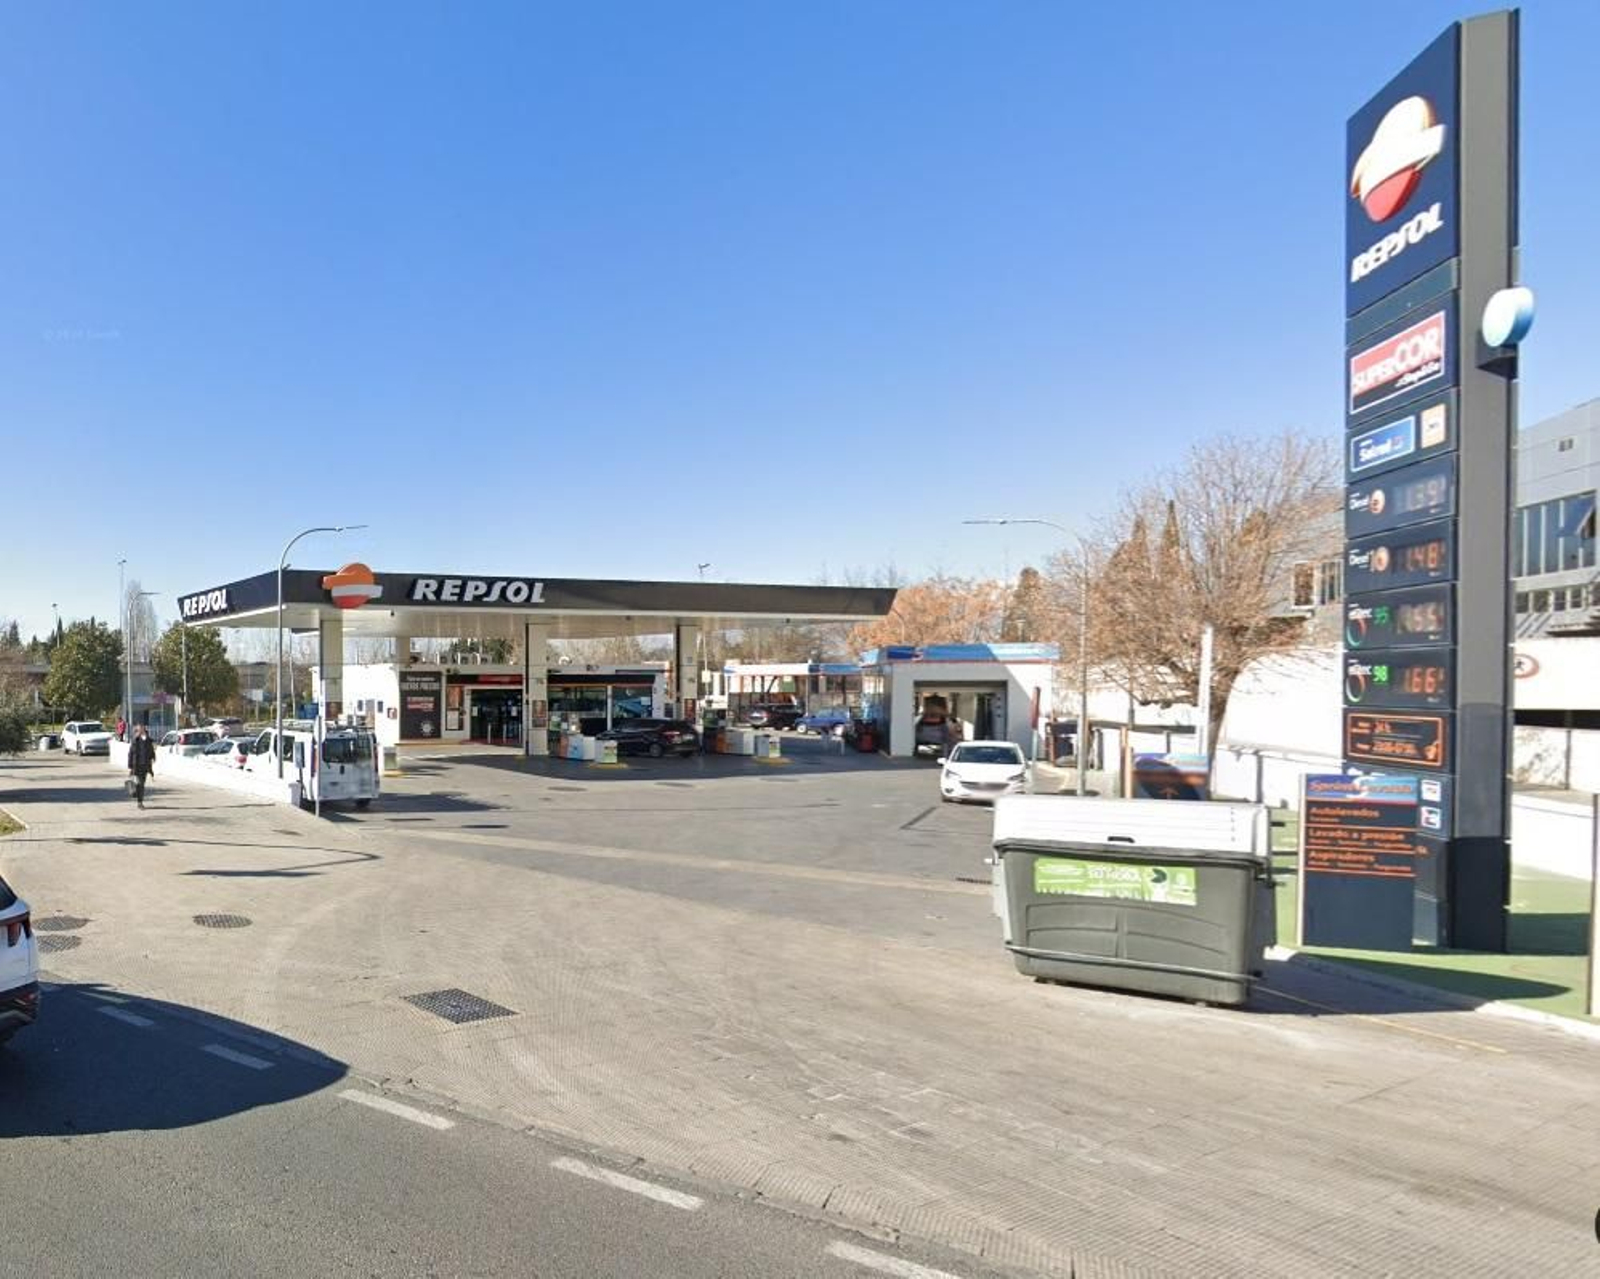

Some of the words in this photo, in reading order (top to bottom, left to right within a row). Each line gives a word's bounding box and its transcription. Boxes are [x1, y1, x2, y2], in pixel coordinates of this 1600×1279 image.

[1350, 202, 1444, 283] REPSOL
[183, 588, 228, 617] REPSOL
[413, 579, 545, 603] REPSOL
[1373, 665, 1387, 682] 98
